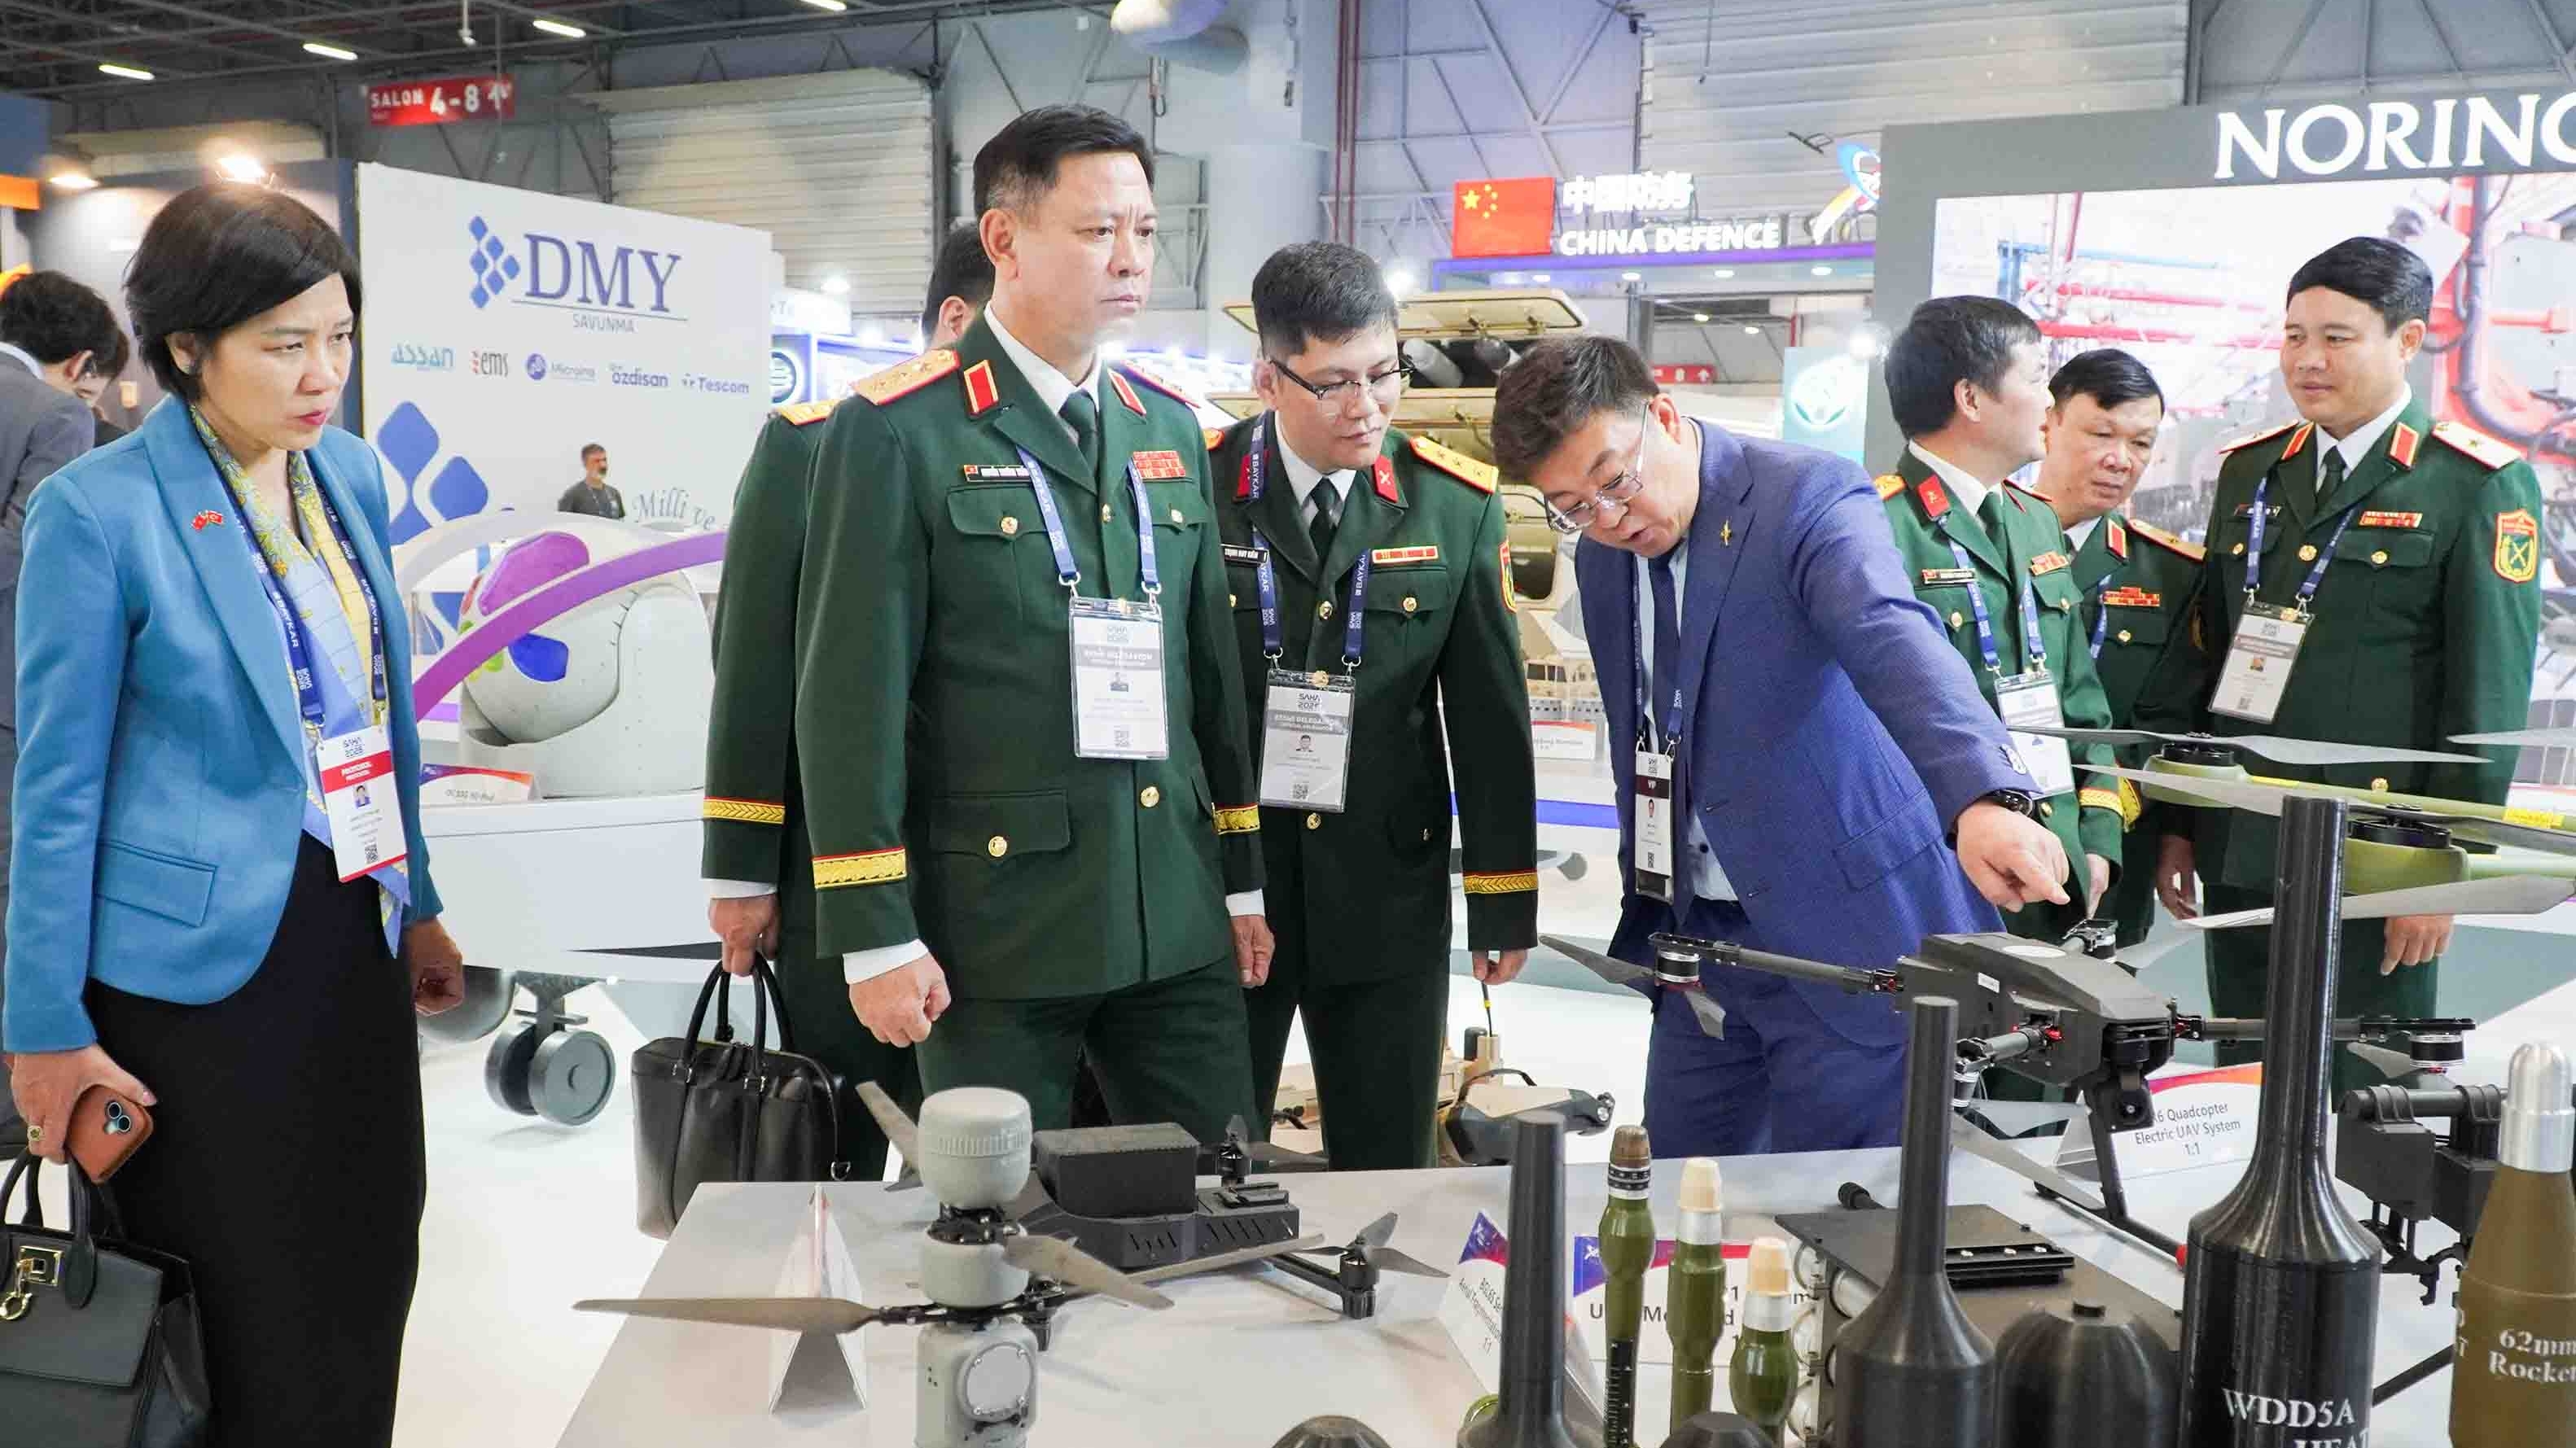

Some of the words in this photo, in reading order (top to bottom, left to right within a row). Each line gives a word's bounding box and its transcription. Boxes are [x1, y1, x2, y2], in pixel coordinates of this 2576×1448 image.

[370, 88, 424, 108] SALON
[1559, 228, 1648, 256] CHINA
[1655, 222, 1780, 253] DEFENCE
[524, 233, 682, 313] DMY
[572, 313, 635, 333] SAVUNMA
[697, 376, 749, 393] Tescom
[1356, 553, 1365, 588] BAYKA
[1299, 693, 1321, 702] SAHA
[2167, 1103, 2228, 1122] Quadcopter
[2135, 1129, 2175, 1145] Electric
[2176, 1125, 2200, 1139] UAV
[2203, 1120, 2241, 1137] System
[2184, 1142, 2201, 1155] 1:1
[2499, 1328, 2576, 1356] 62mm
[2221, 1387, 2356, 1428] WDD5A
